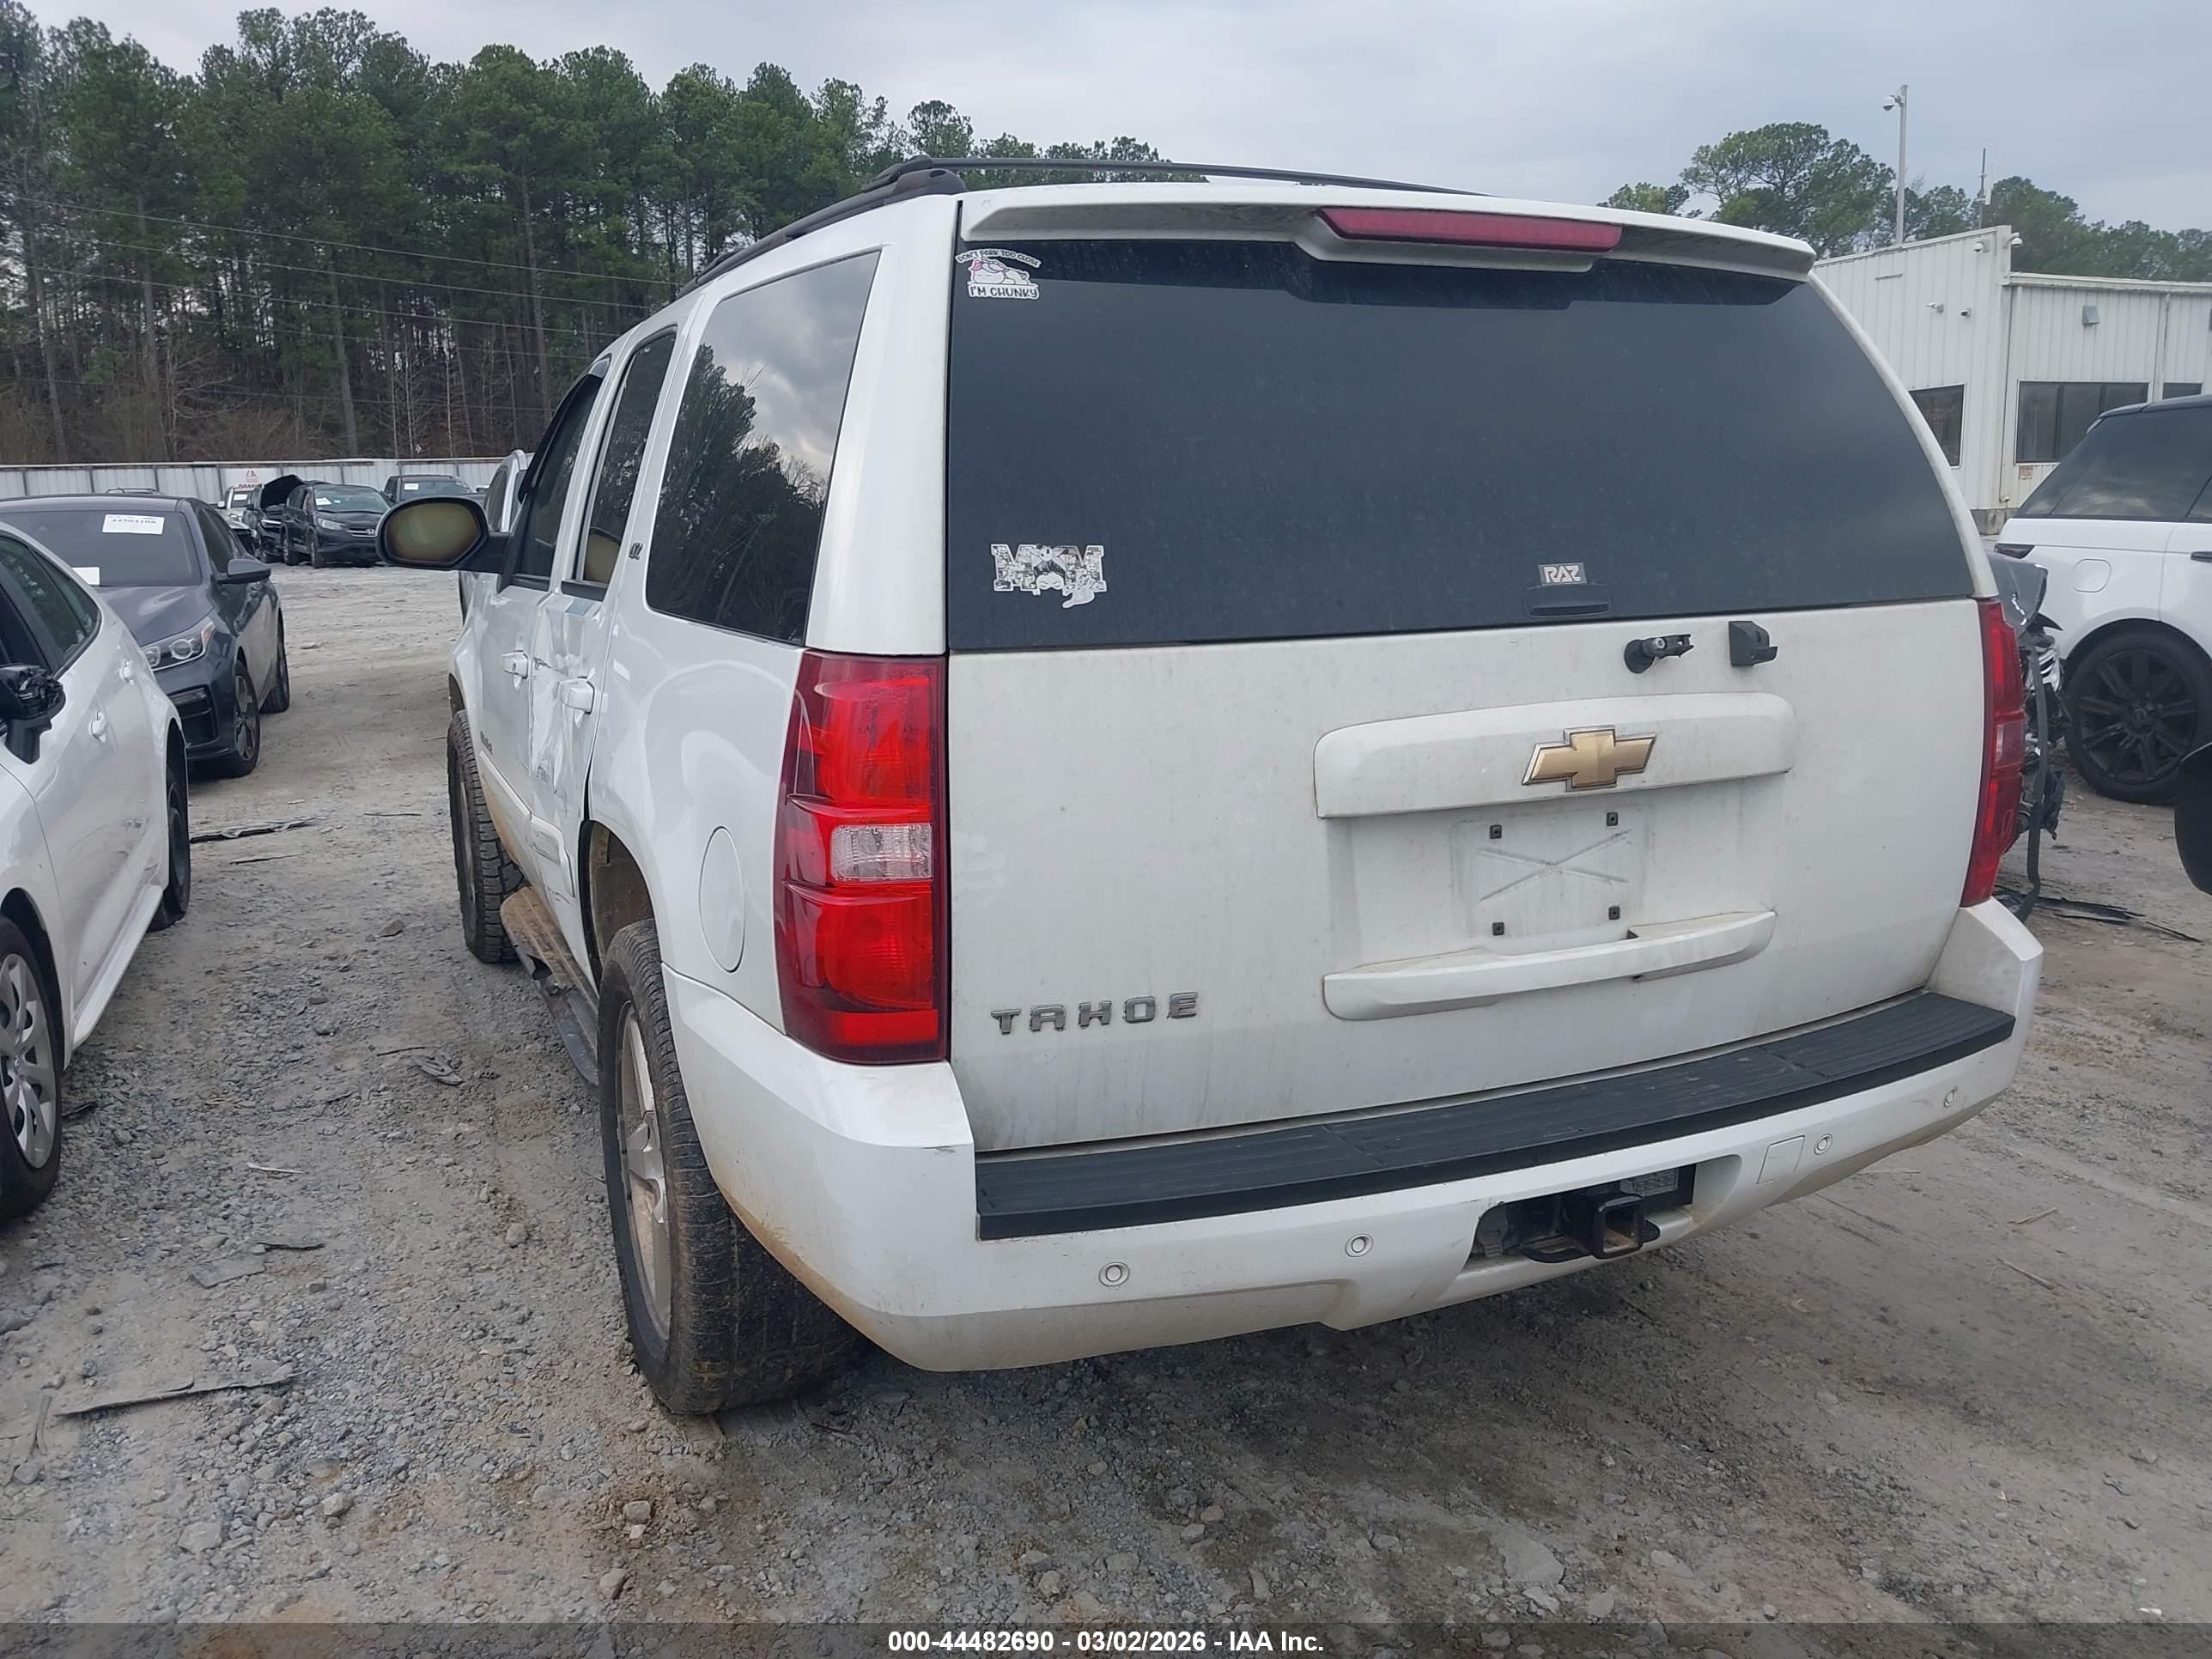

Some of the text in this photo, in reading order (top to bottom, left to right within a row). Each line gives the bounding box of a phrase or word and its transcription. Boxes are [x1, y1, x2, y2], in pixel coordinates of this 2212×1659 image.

[1000, 250, 1017, 258] TOO
[1017, 253, 1040, 267] CLOSE
[970, 286, 1037, 299] I'M CHUNKY
[991, 991, 1198, 1035] TAHOE
